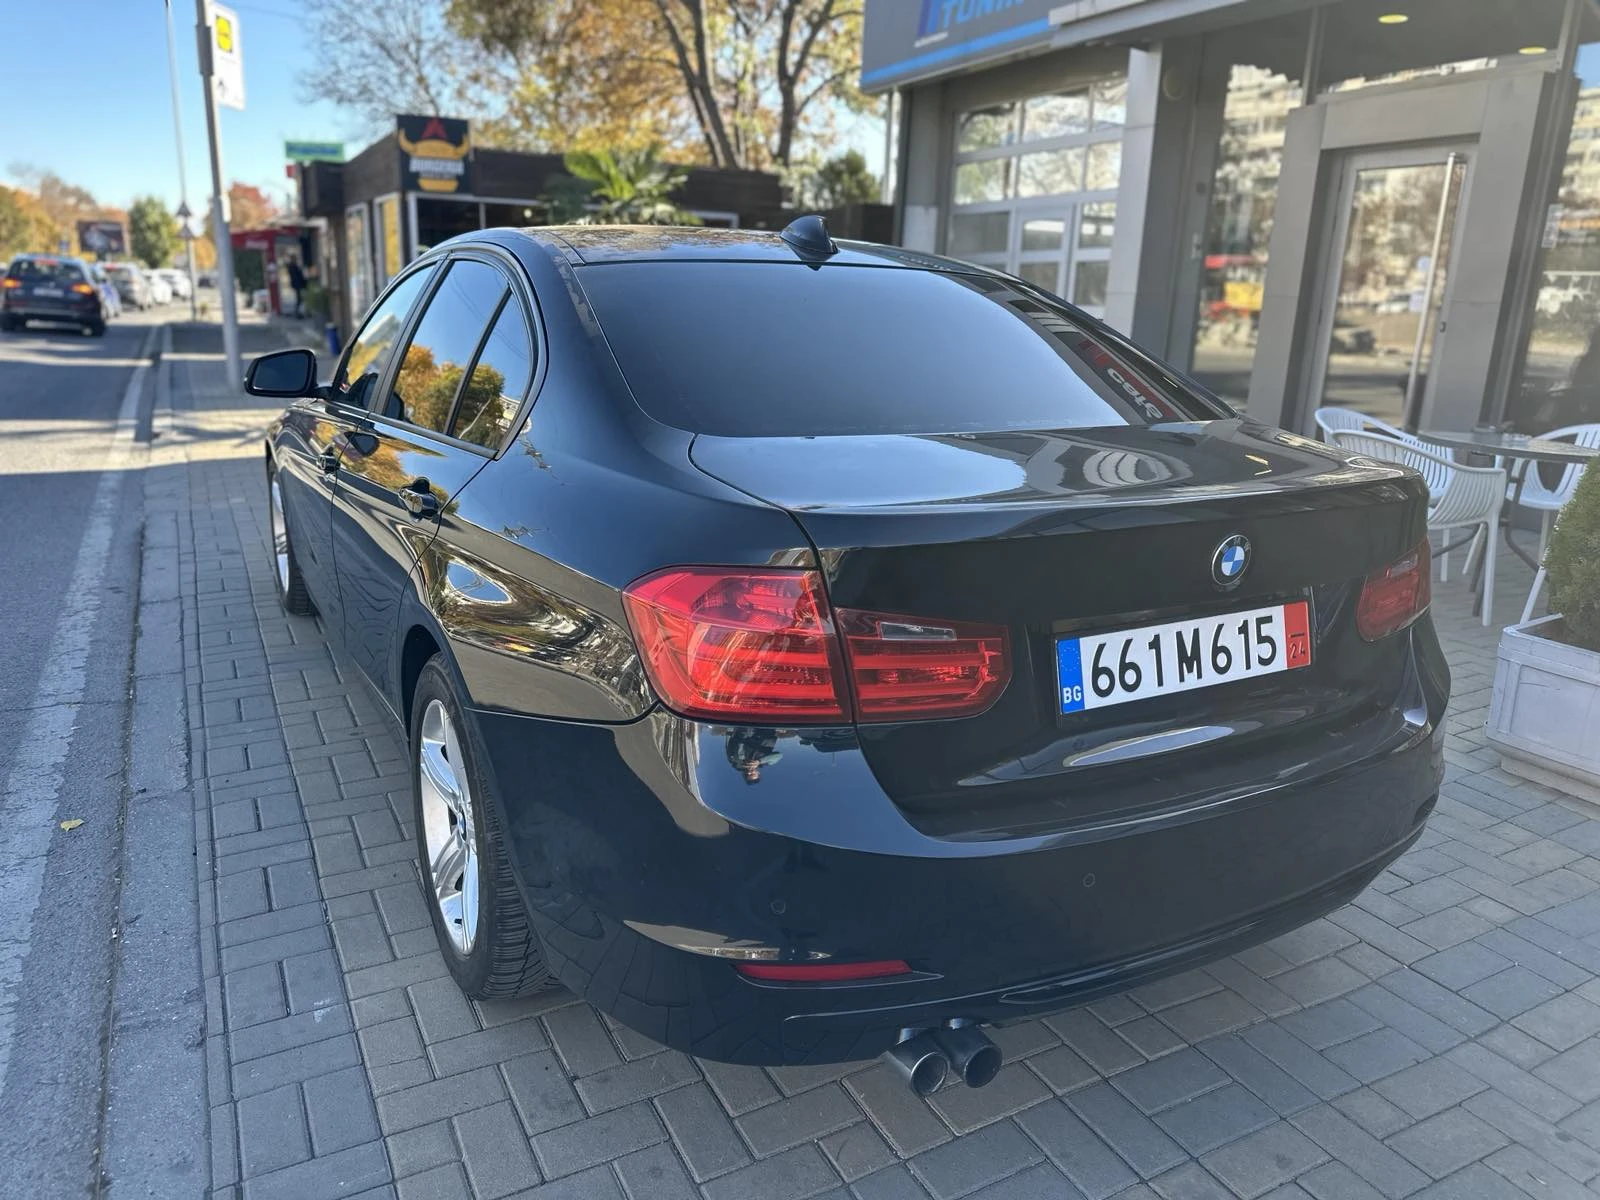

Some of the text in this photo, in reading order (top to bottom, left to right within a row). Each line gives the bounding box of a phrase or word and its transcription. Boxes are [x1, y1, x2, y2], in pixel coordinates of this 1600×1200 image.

[1091, 615, 1277, 698] 661M615
[1290, 641, 1305, 659] 24
[1063, 685, 1082, 704] BG
